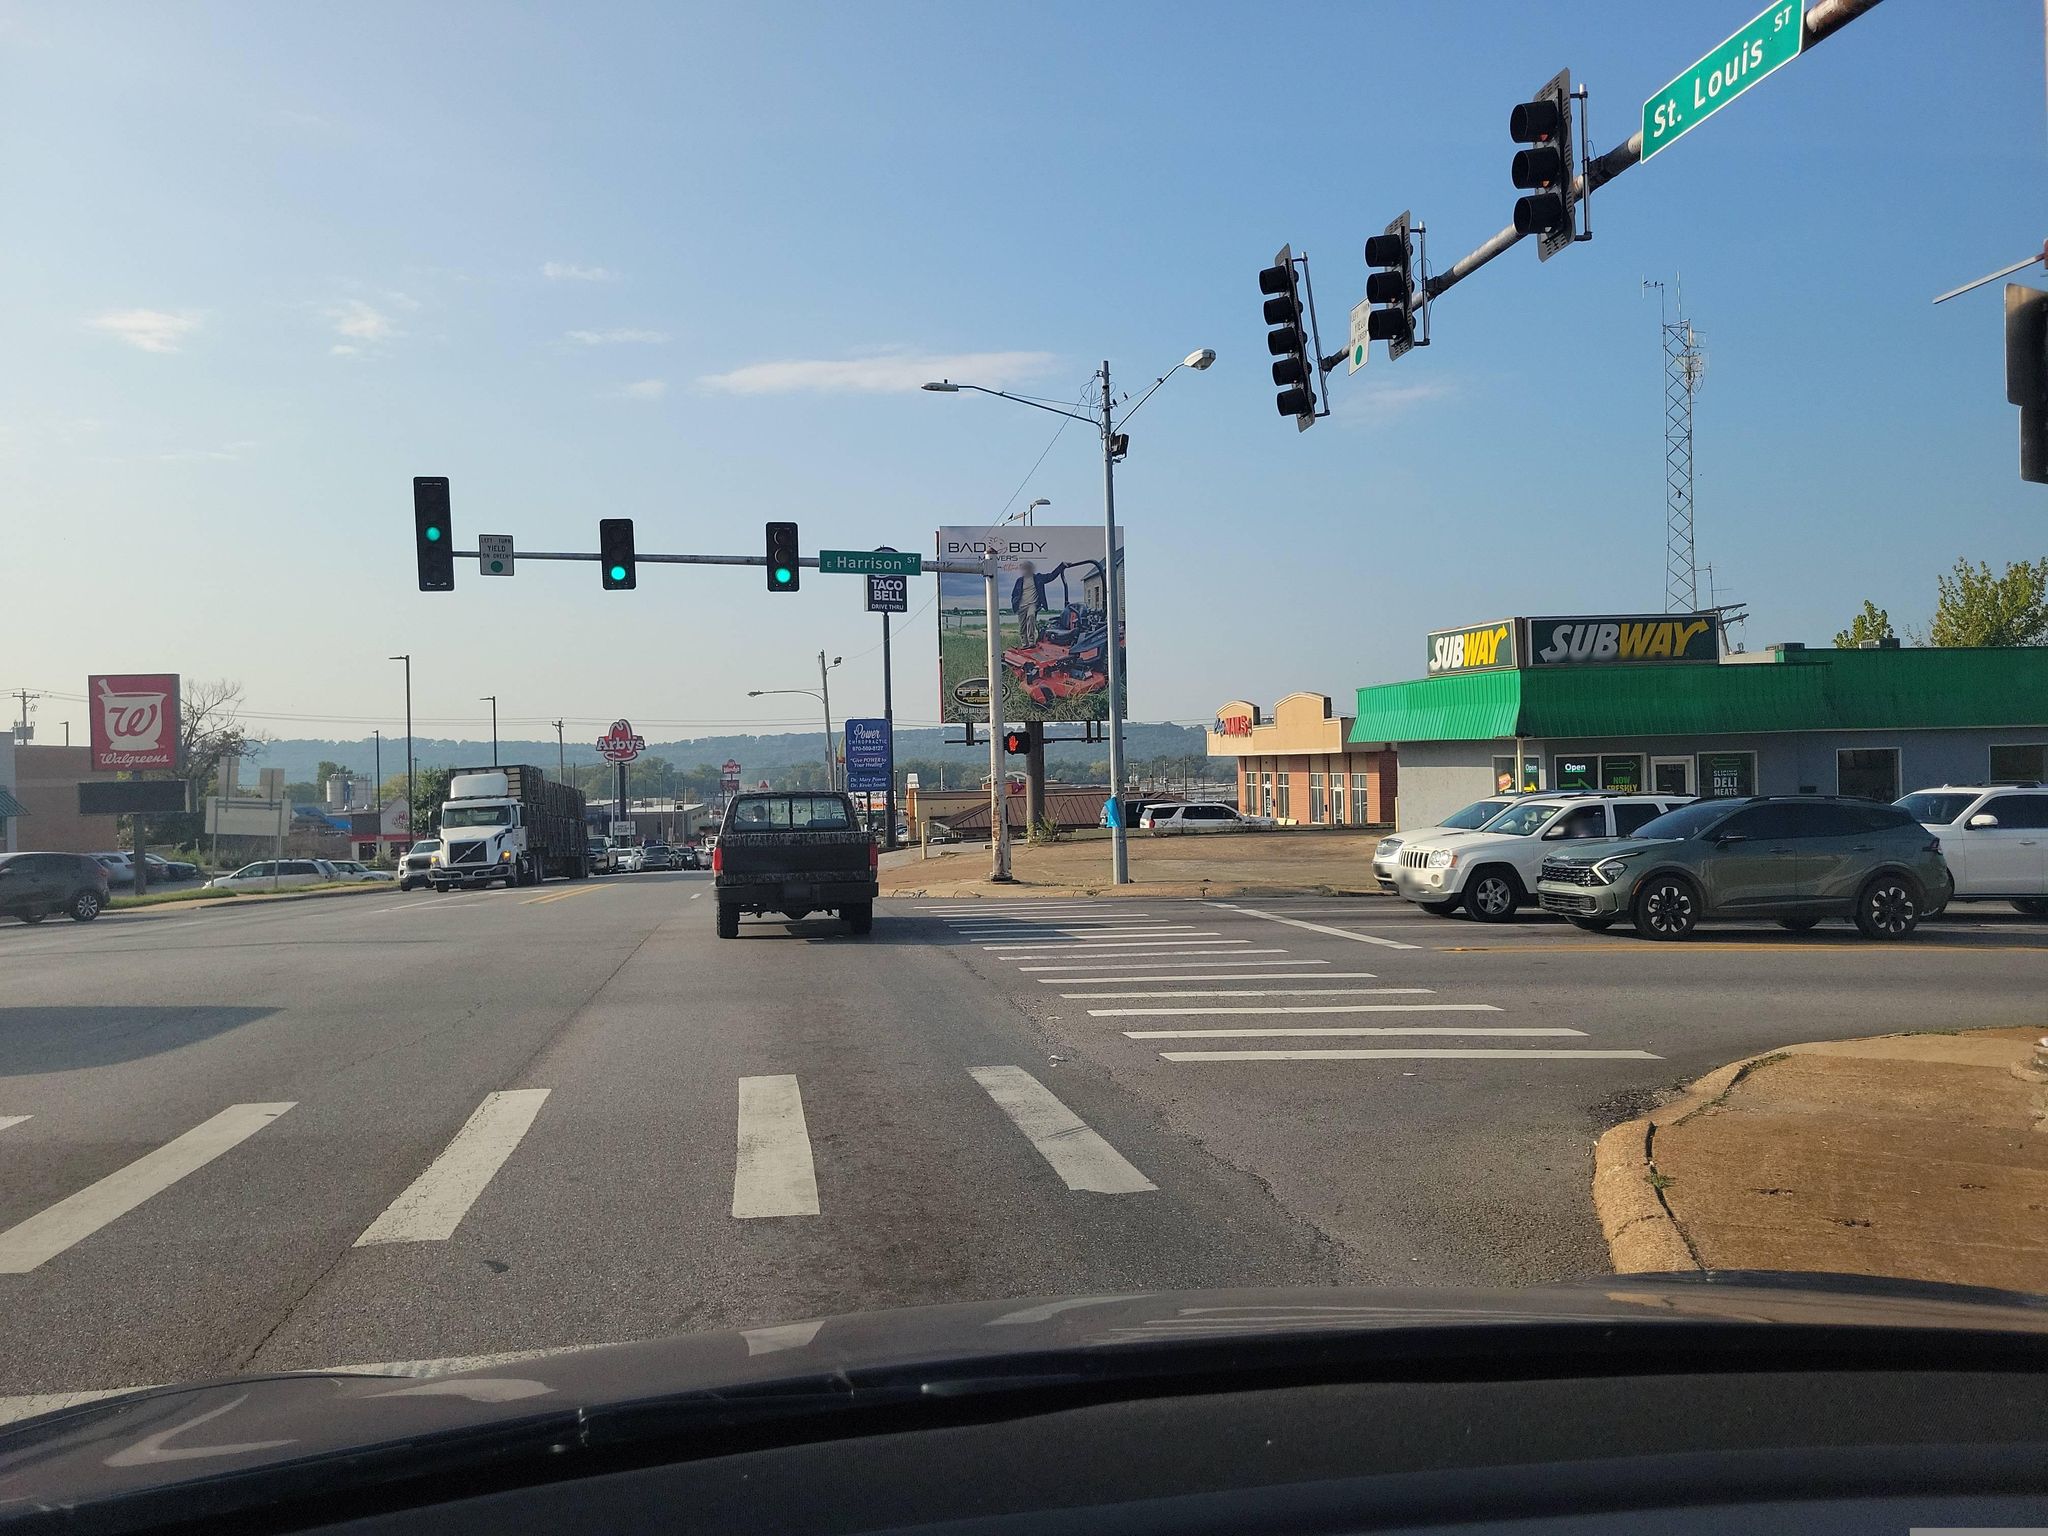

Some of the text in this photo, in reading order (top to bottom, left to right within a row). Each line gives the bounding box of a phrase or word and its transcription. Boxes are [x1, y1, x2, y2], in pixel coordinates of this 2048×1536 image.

[1653, 5, 1792, 138] St. Louis ST
[948, 542, 1047, 553] BAD BOY
[837, 556, 902, 570] Harrison
[907, 556, 916, 564] ST
[871, 579, 903, 591] TACO
[873, 591, 903, 602] BELL
[1539, 619, 1709, 662] SUBWAY
[1429, 624, 1508, 670] SUBWAY
[853, 723, 881, 742] Power
[597, 737, 645, 753] Arby's
[100, 752, 169, 768] Walgreens
[1525, 763, 1537, 772] Open
[1564, 763, 1586, 771] Open
[1613, 776, 1631, 785] NOW
[1714, 777, 1737, 788] DELI
[1714, 788, 1738, 796] MEATS
